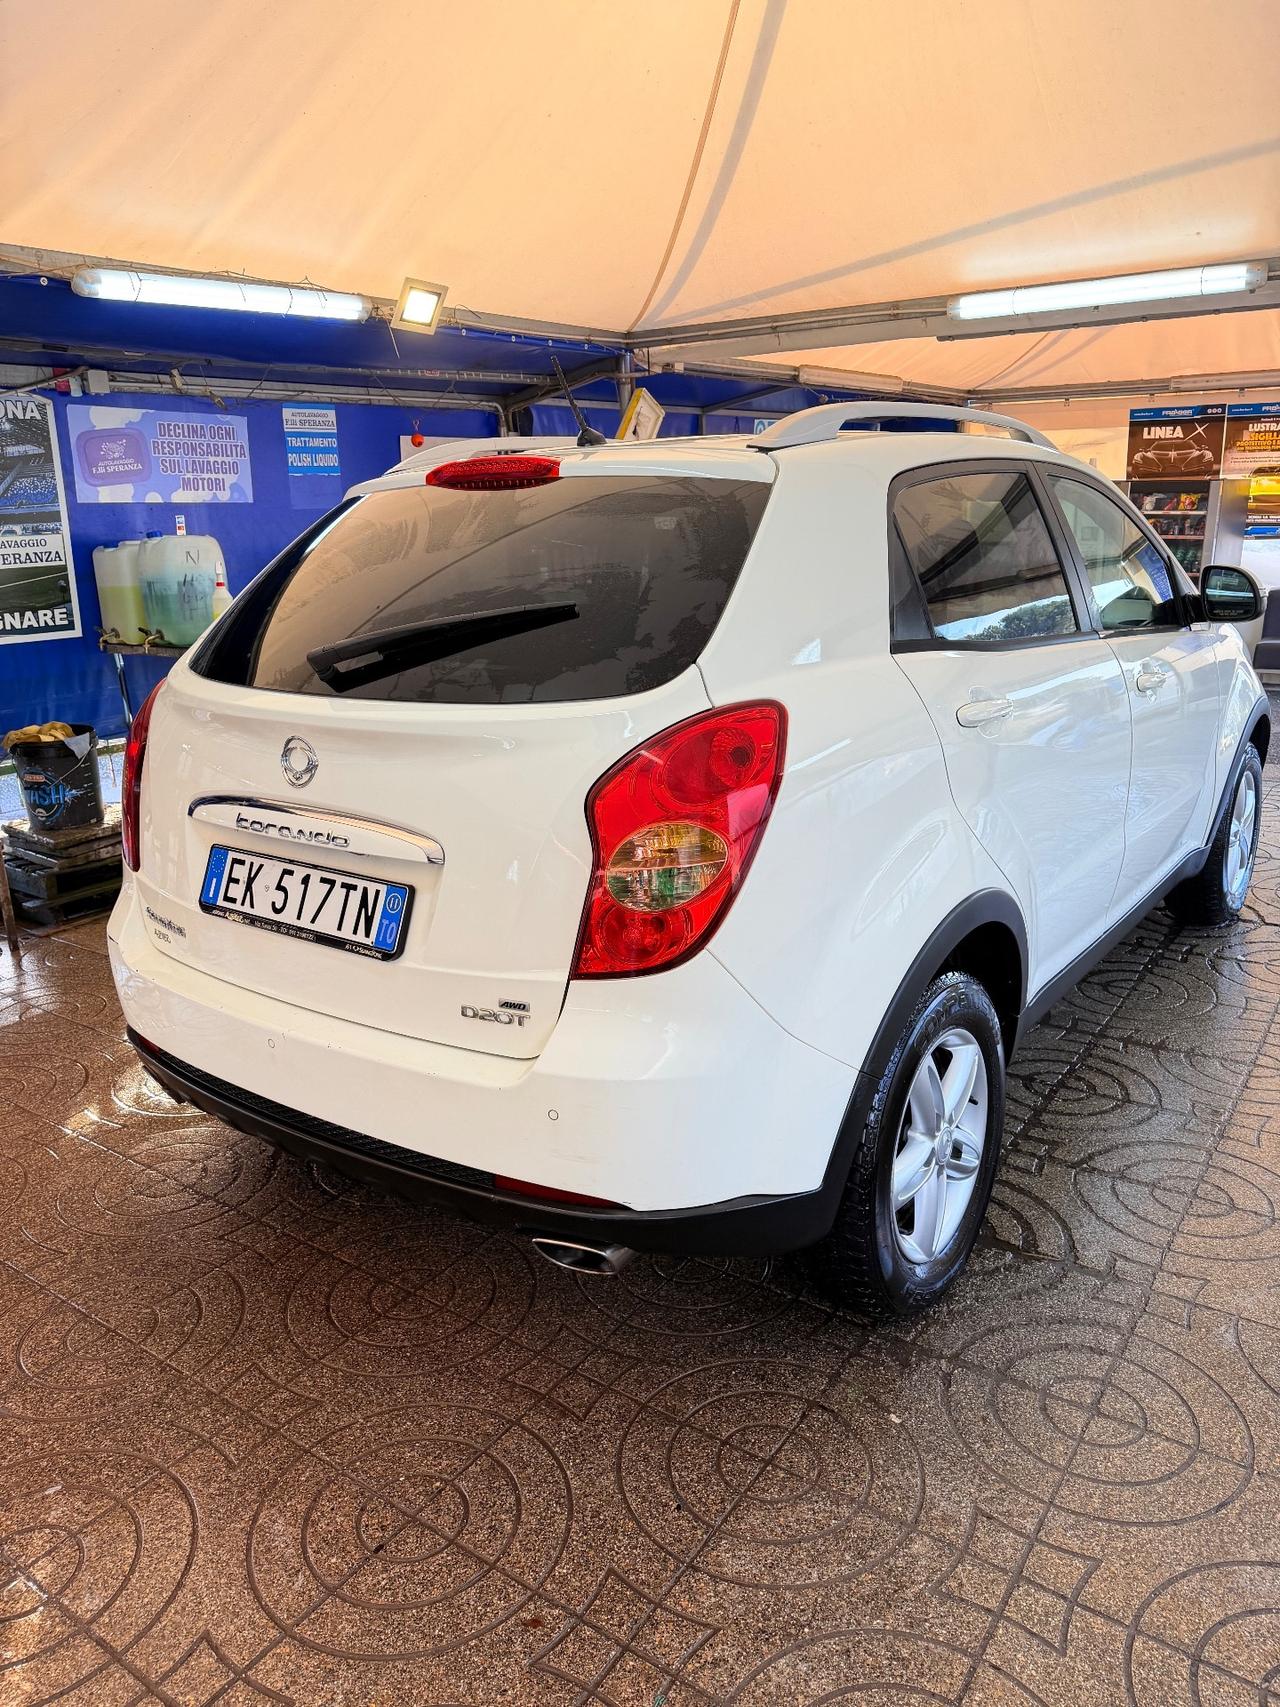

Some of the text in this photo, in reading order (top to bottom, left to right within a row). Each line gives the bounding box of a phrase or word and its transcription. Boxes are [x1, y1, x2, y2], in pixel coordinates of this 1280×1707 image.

[299, 419, 336, 428] SPERANZA
[156, 421, 236, 442] DECLINA OGNI
[1143, 426, 1185, 440] LINEA
[151, 440, 248, 459] RESPONSABILITÀ
[287, 437, 338, 448] TRATTAMENTO
[98, 458, 135, 466] AUTOLAVAGGIO
[160, 457, 240, 476] SUL LAVAGGIO
[288, 453, 339, 467] POLISH LIQUIDO
[106, 463, 143, 473] SPERANZA
[181, 476, 227, 492] MOTORI
[223, 857, 381, 939] EK 517TN
[379, 918, 396, 944] TO
[500, 1001, 527, 1011] AWD
[461, 1005, 531, 1027] D20T
